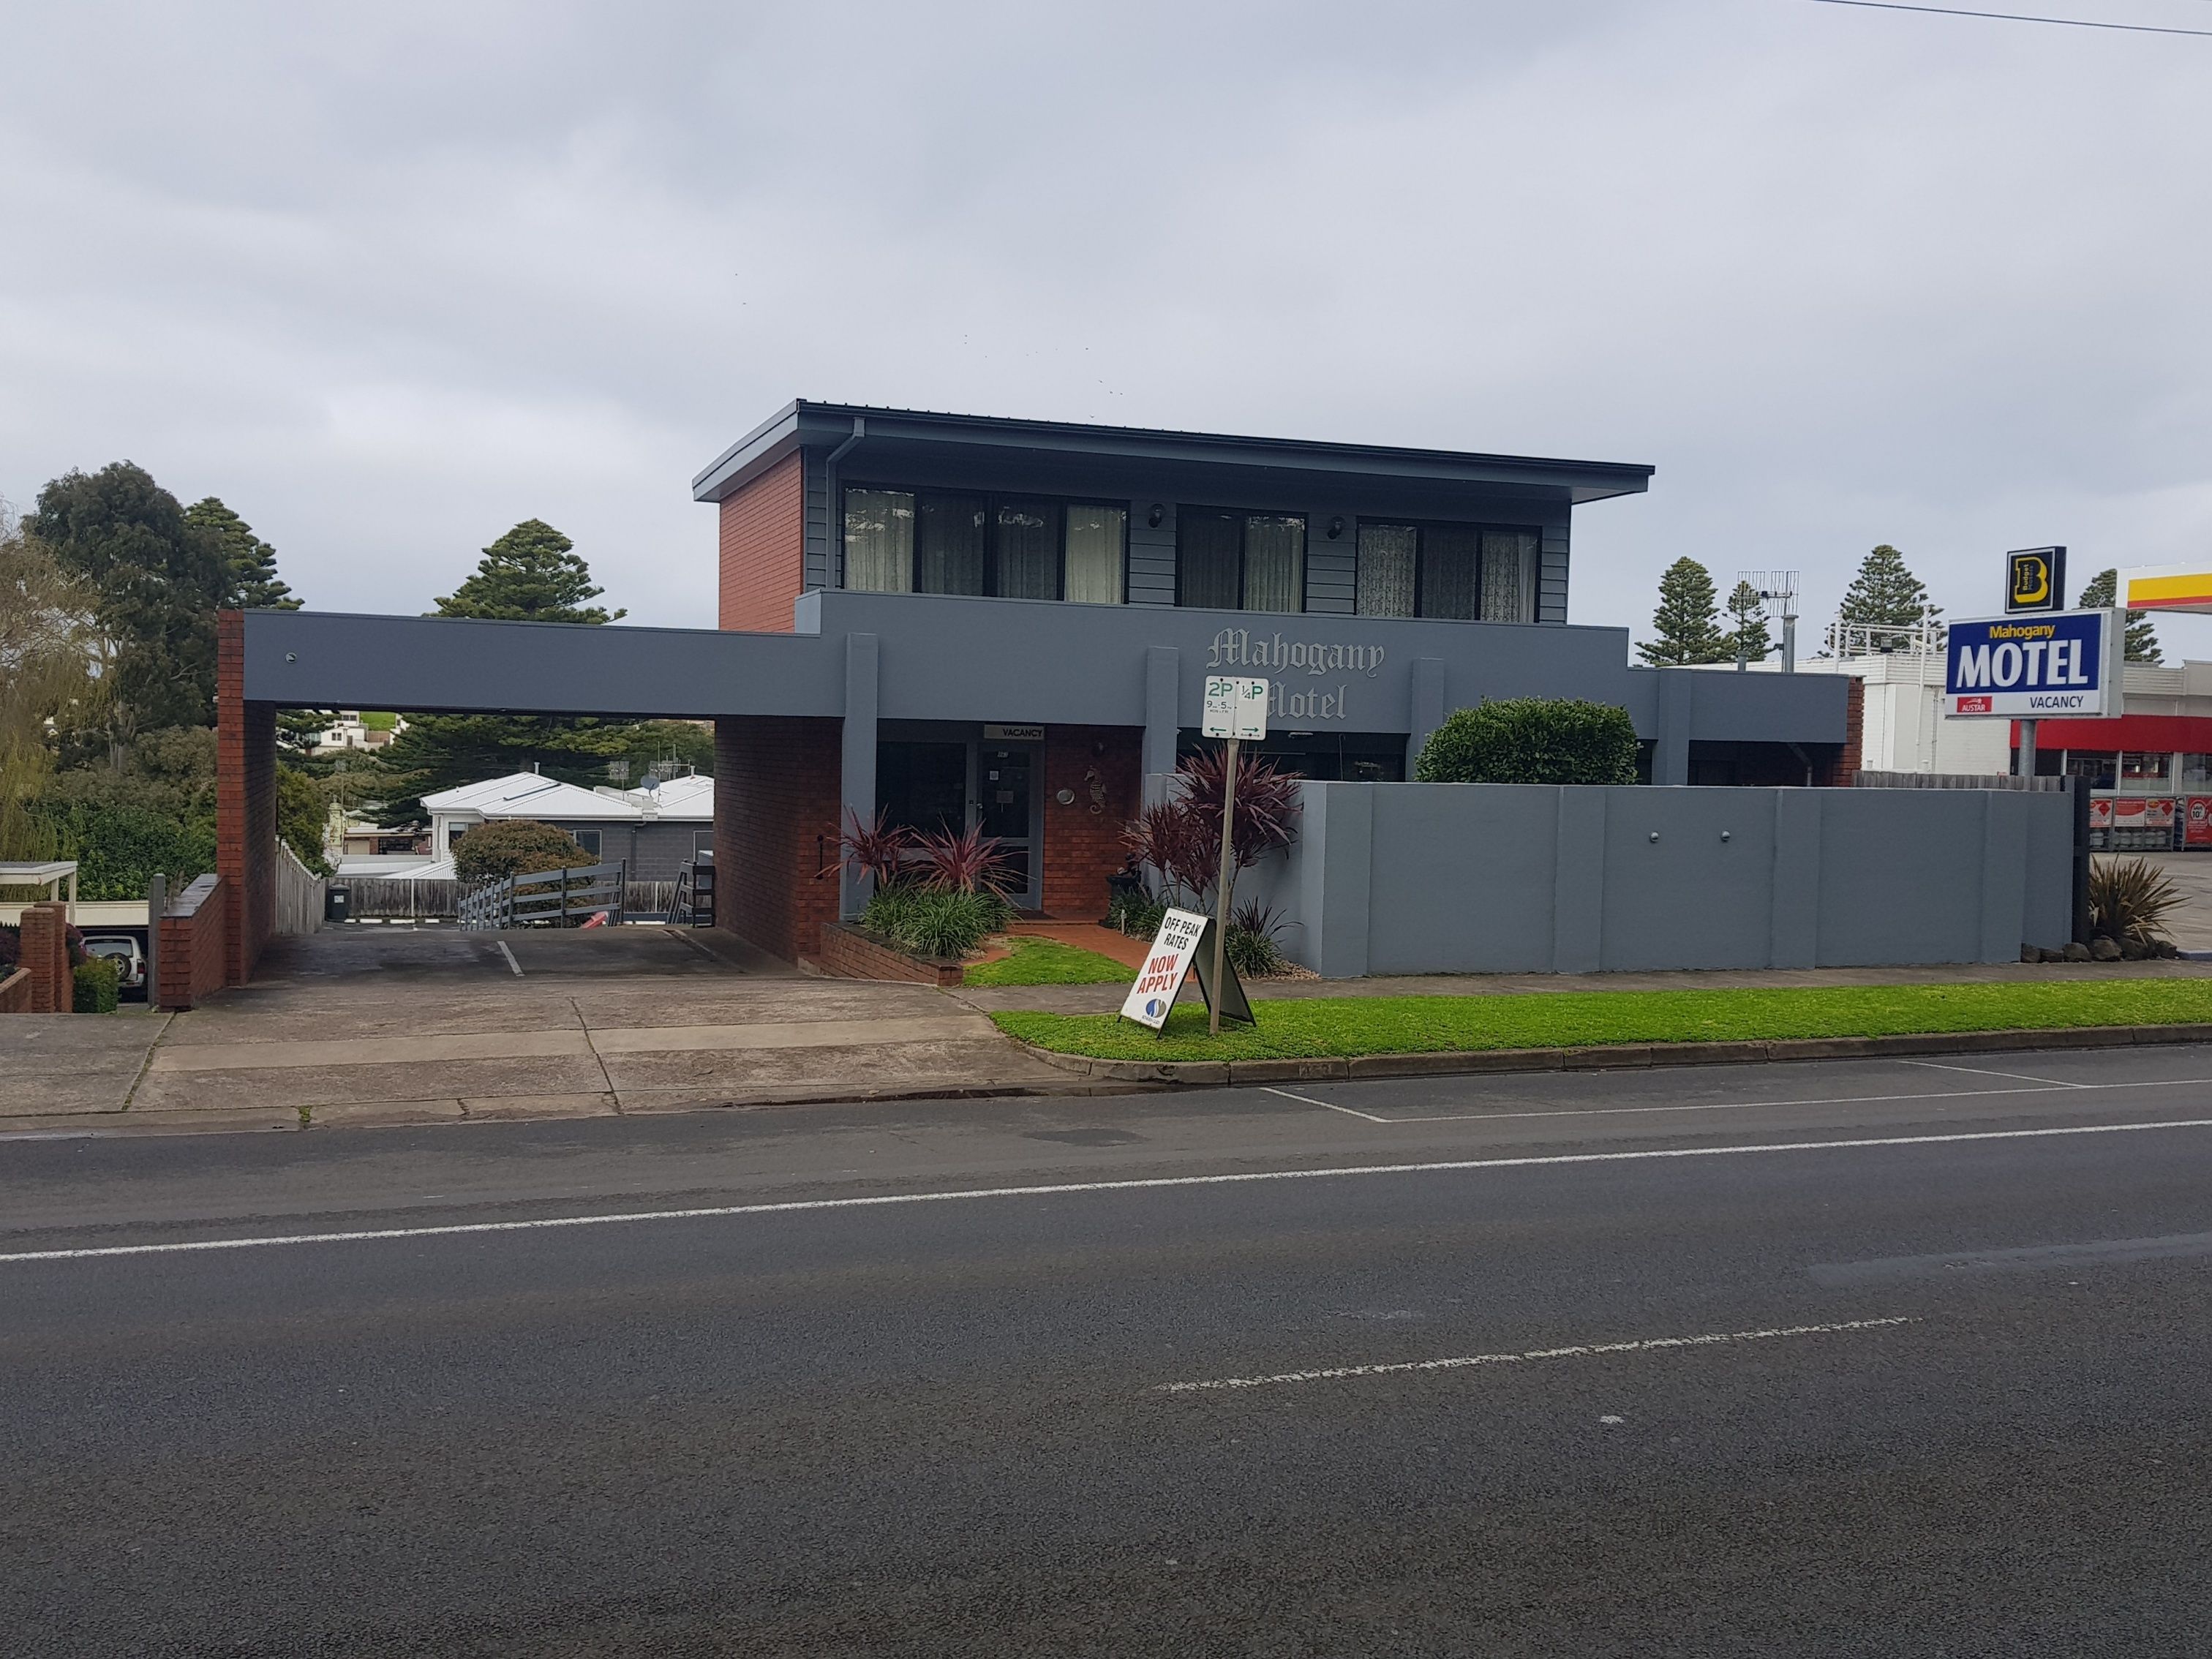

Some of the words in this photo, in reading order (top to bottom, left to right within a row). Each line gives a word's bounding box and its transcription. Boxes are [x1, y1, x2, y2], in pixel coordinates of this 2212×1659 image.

[2014, 557, 2048, 603] B
[1990, 623, 2055, 640] Mahogany
[1206, 628, 1385, 678] Mahogany
[1956, 639, 2089, 688] MOTEL
[1208, 682, 1233, 697] 2P
[1962, 704, 1986, 712] AUSTAR
[2030, 696, 2084, 709] VACANCY
[1003, 729, 1042, 737] VACANCY
[1164, 917, 1180, 932] OFF
[1181, 921, 1201, 937] PEAK
[1164, 933, 1189, 950] RATES
[1148, 953, 1179, 974] NOW
[1137, 972, 1178, 994] APPLY
